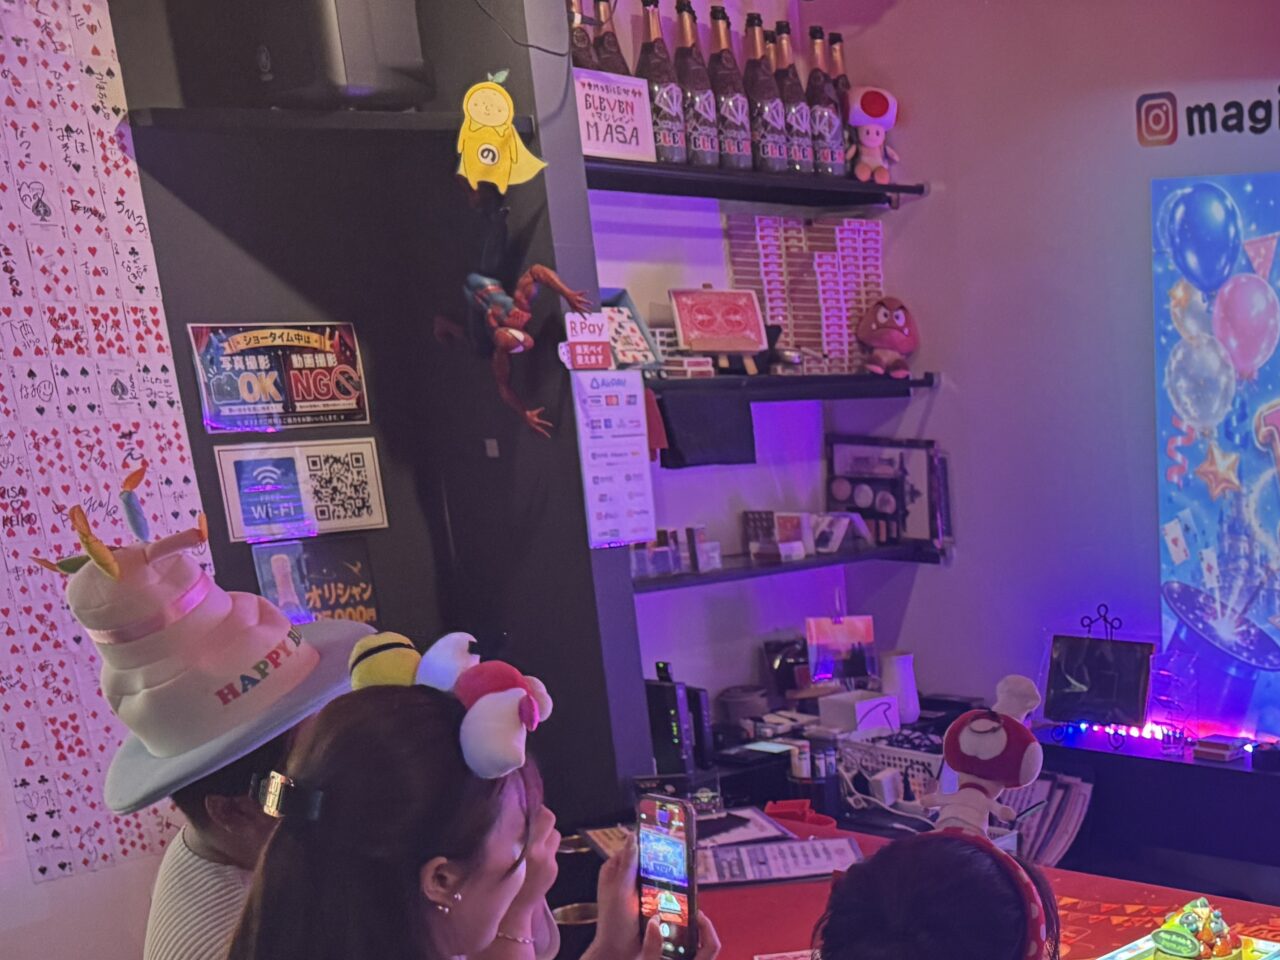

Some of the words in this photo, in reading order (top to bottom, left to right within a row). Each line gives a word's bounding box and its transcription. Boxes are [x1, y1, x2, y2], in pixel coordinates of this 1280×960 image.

[584, 93, 634, 115] ELEVEN
[586, 121, 640, 146] MASA
[481, 148, 497, 163] の
[580, 321, 604, 336] Pay
[243, 331, 311, 346] ショータイム中は
[219, 354, 271, 371] 写真撮影
[291, 352, 338, 369] 動画撮影
[238, 370, 283, 403] OK
[290, 369, 333, 401] NG
[2, 512, 38, 528] KEIKO
[251, 502, 296, 520] Wi-Fi
[305, 581, 373, 609] オリシャン
[215, 640, 293, 706] HAPPY
